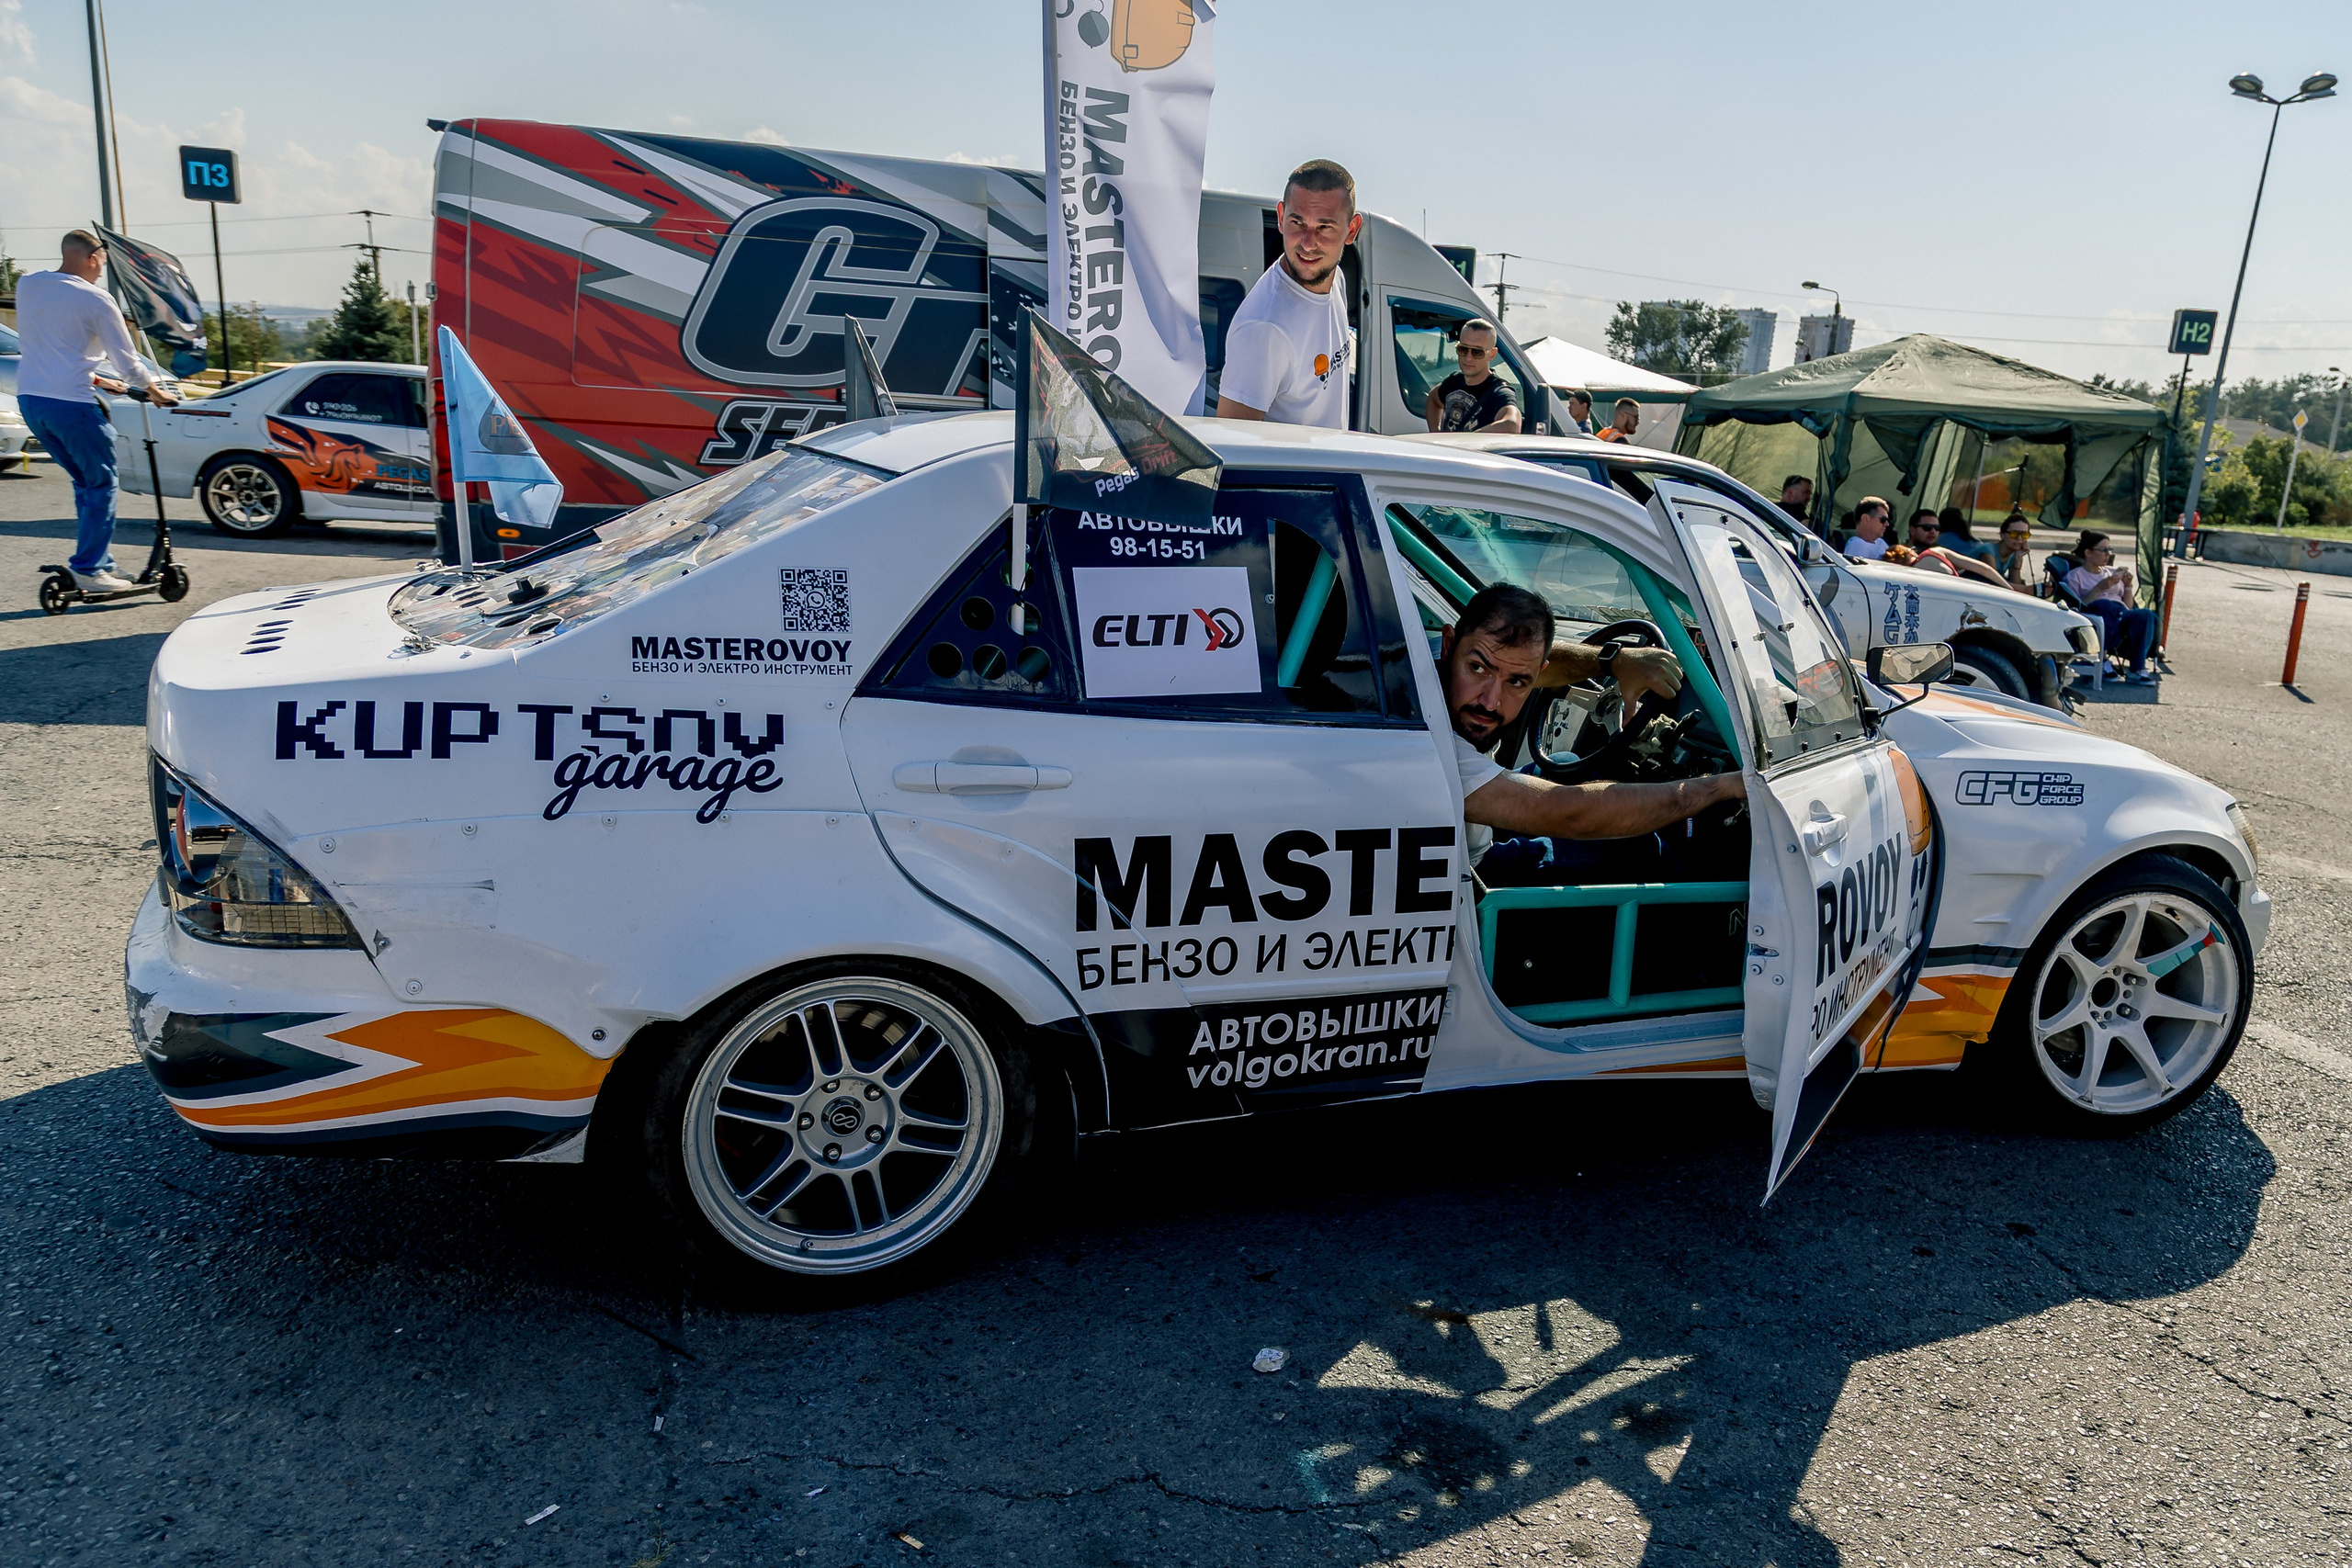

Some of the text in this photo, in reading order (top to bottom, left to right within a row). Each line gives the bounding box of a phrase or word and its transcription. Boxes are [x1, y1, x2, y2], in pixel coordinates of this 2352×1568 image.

[1058, 79, 1080, 171] БЕНЗО
[1061, 176, 1077, 195] И
[1062, 203, 1083, 321] ЭЛЕКТРО
[376, 464, 430, 481] PEGAS
[1094, 466, 1140, 497] Pegas
[1110, 536, 1205, 560] 98-15-51
[631, 636, 853, 662] MASTEROVOY
[632, 661, 854, 675] БЕНЗО И ЭЛЕКТРО ИНСТРУМЕНТ
[542, 746, 783, 824] garage
[1955, 771, 2041, 806] CFG
[2041, 784, 2083, 794] FORCE
[2042, 773, 2071, 783] CHIP
[2039, 795, 2083, 805] GROUP
[1074, 826, 1455, 932] MASTE
[1815, 831, 1901, 989] ROVOY
[1076, 936, 1238, 992] БЕНЗО
[1256, 933, 1286, 974] И
[1826, 925, 1897, 1030] ИНСТРУМЕНТ
[1189, 995, 1442, 1055] АВТОВЫШКИ
[1186, 1034, 1436, 1089] volgokran.ru
